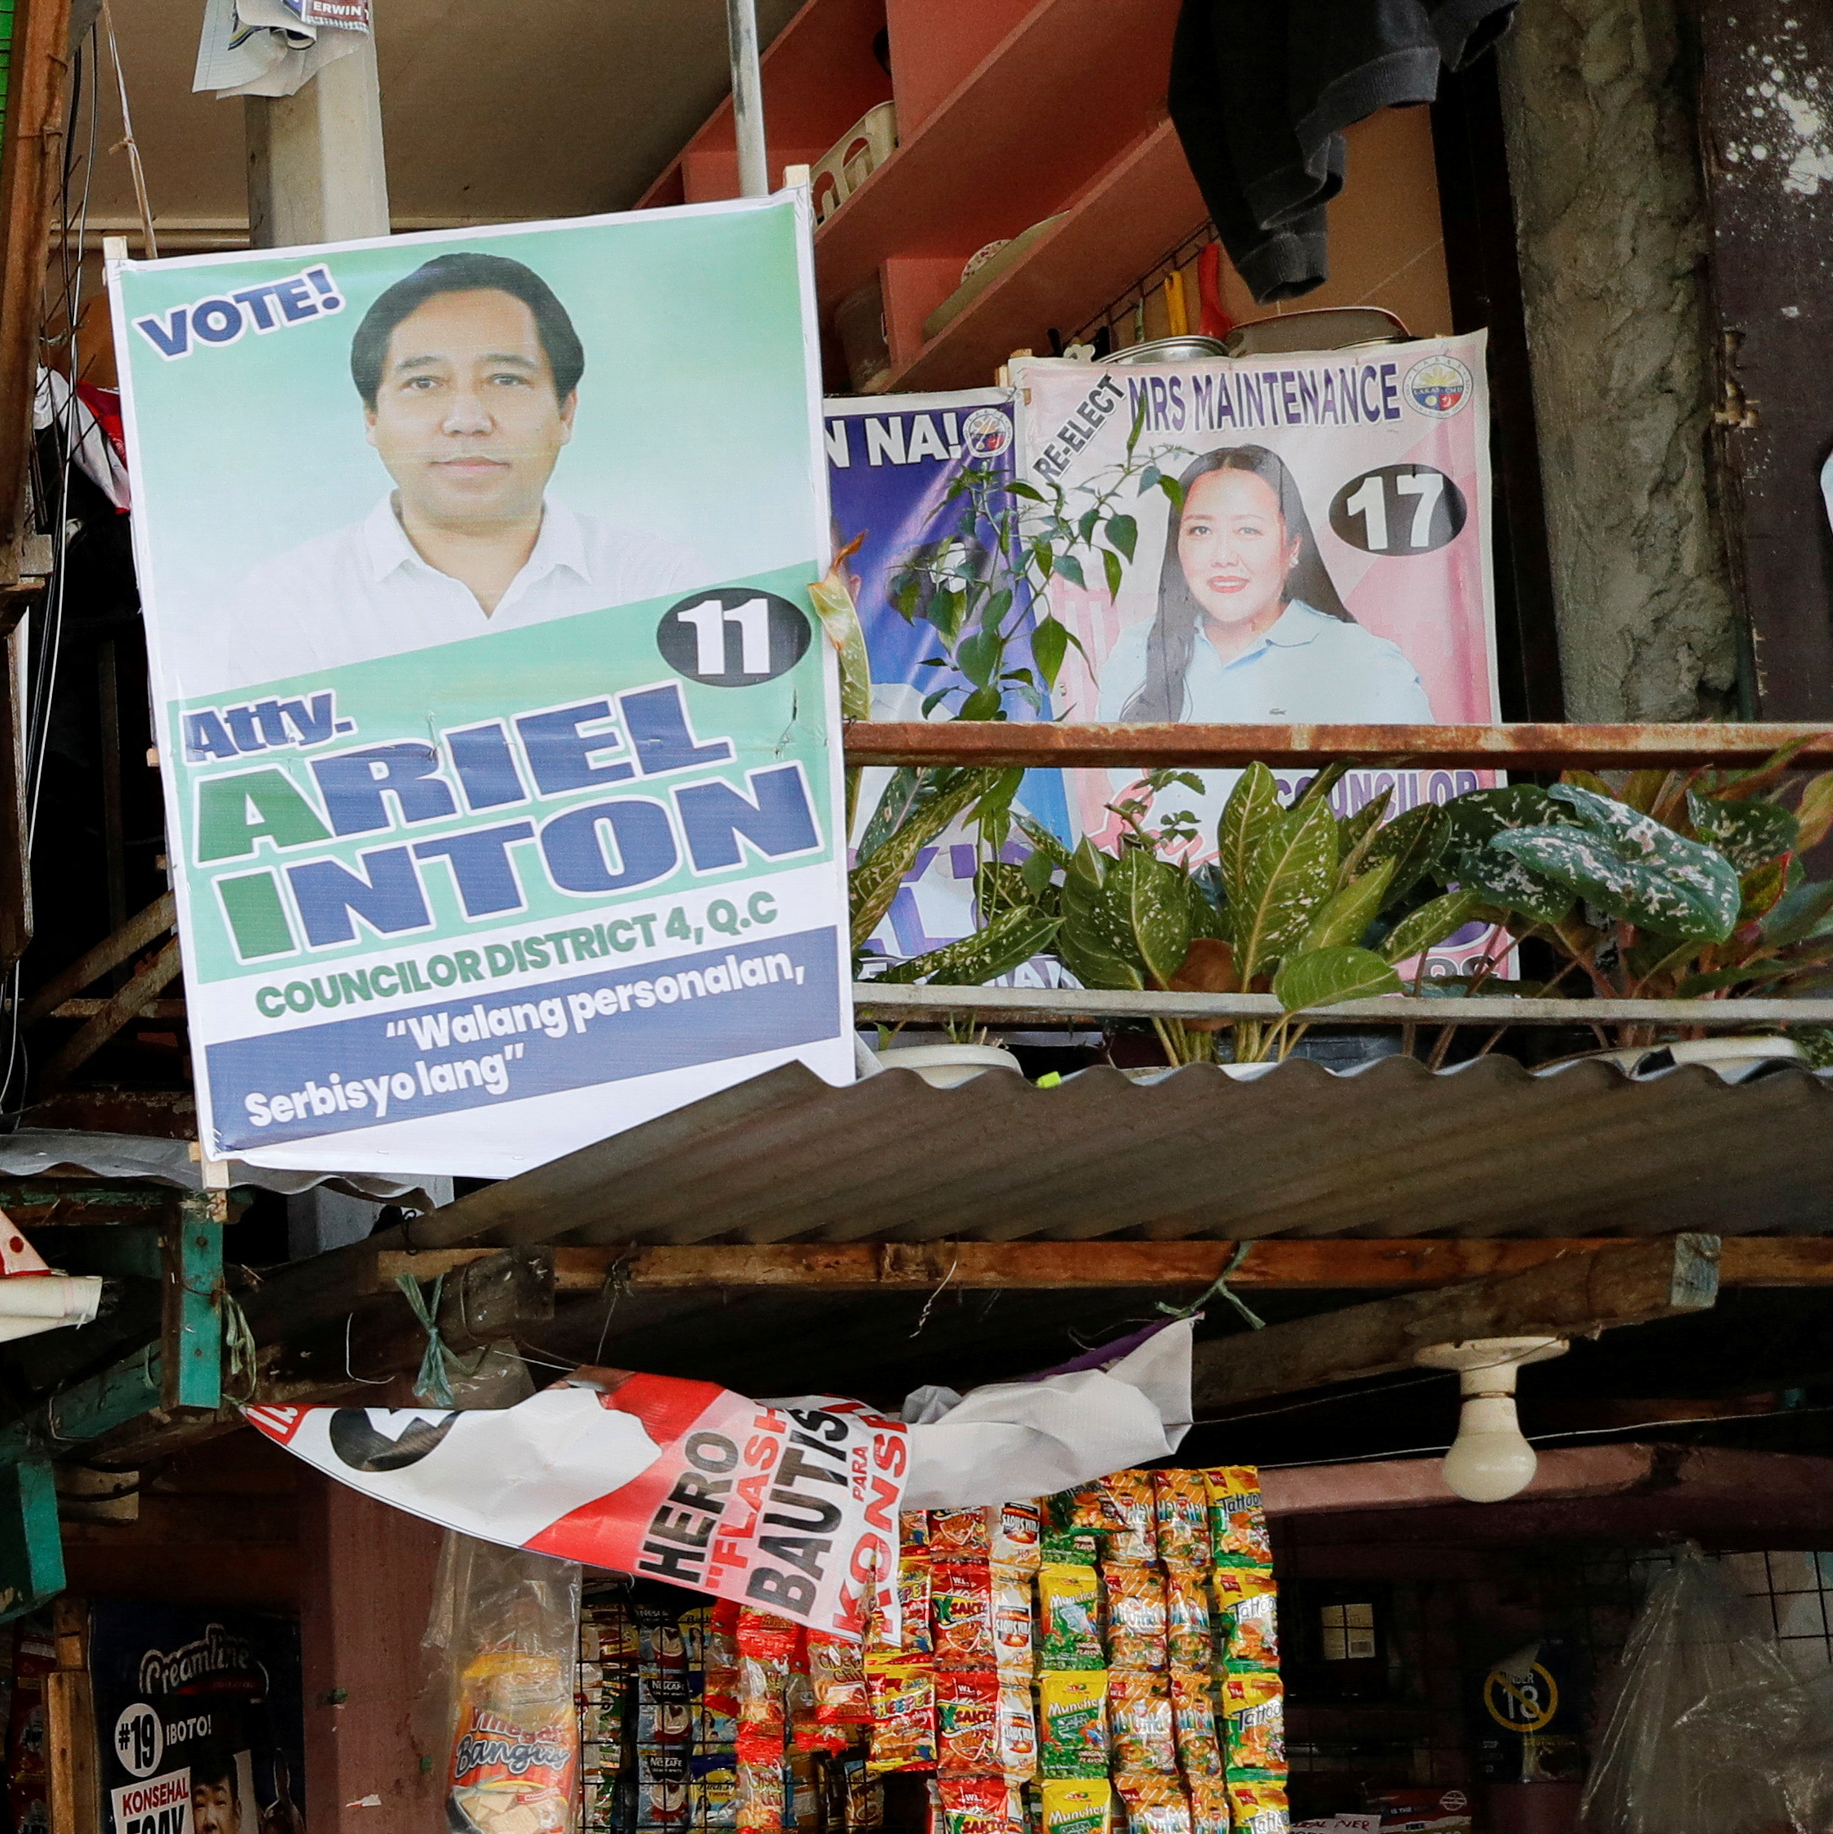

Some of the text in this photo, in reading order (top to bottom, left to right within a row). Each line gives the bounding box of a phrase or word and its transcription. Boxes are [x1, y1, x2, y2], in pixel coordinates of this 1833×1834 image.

[313, 2, 362, 16] ERWIN
[136, 263, 346, 360] VOTE!
[1033, 373, 1124, 483] RE-ELECT
[1189, 363, 1400, 428] MAINTENANCE
[1345, 472, 1444, 549] 17
[674, 596, 776, 678] 11
[182, 689, 356, 764] Atty.
[196, 678, 735, 865] ARIEL
[213, 762, 824, 966] INTON
[255, 914, 656, 1021] COUNCILOR DISTRICT
[243, 1060, 416, 1132] Serbisyo
[637, 1430, 739, 1584] HERO
[141, 1622, 251, 1694] Creamline
[455, 1741, 570, 1776] Bangus
[122, 1782, 190, 1817] KONSEHAL
